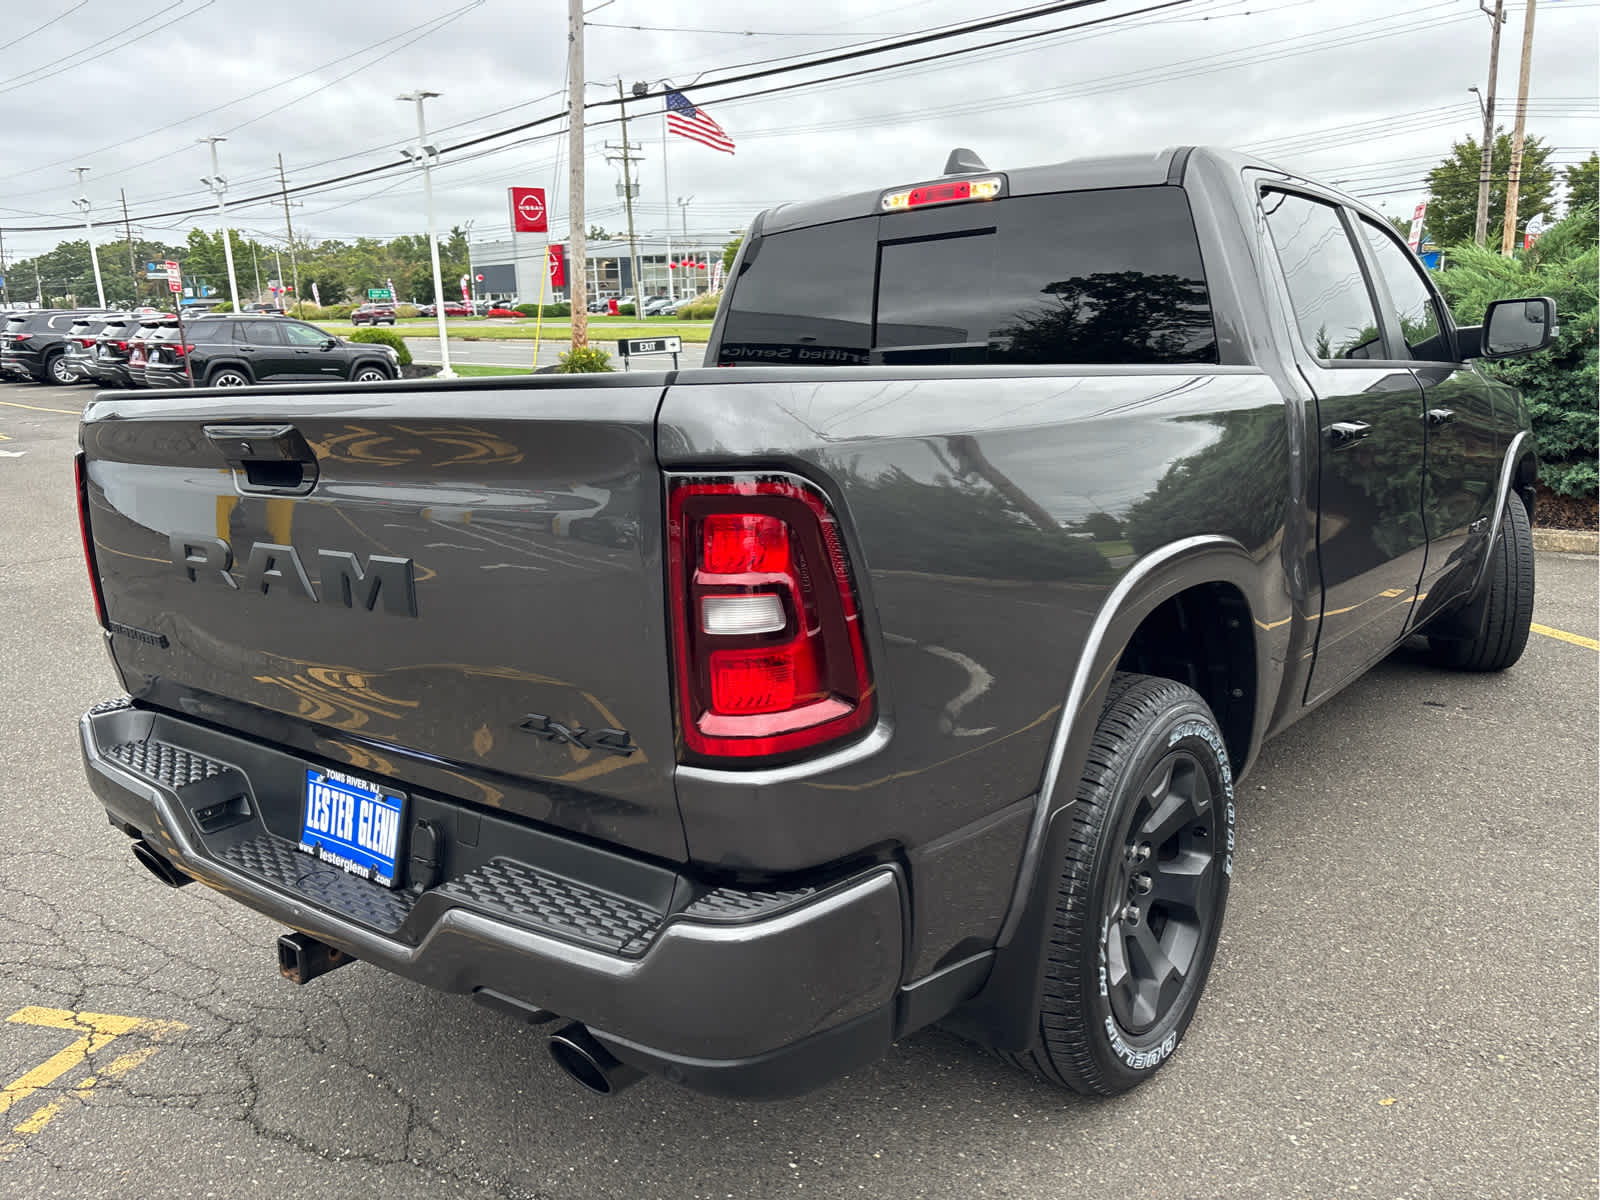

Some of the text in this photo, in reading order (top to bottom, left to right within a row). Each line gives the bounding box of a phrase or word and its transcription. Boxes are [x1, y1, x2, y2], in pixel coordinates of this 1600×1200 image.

[640, 342, 656, 352] EXIT
[168, 533, 418, 619] RAM
[326, 769, 380, 794] TOMS RIVER, NJ
[306, 783, 399, 859] LESTER GLENN
[319, 847, 370, 879] lesterglenn
[1104, 1015, 1177, 1070] DUELER
